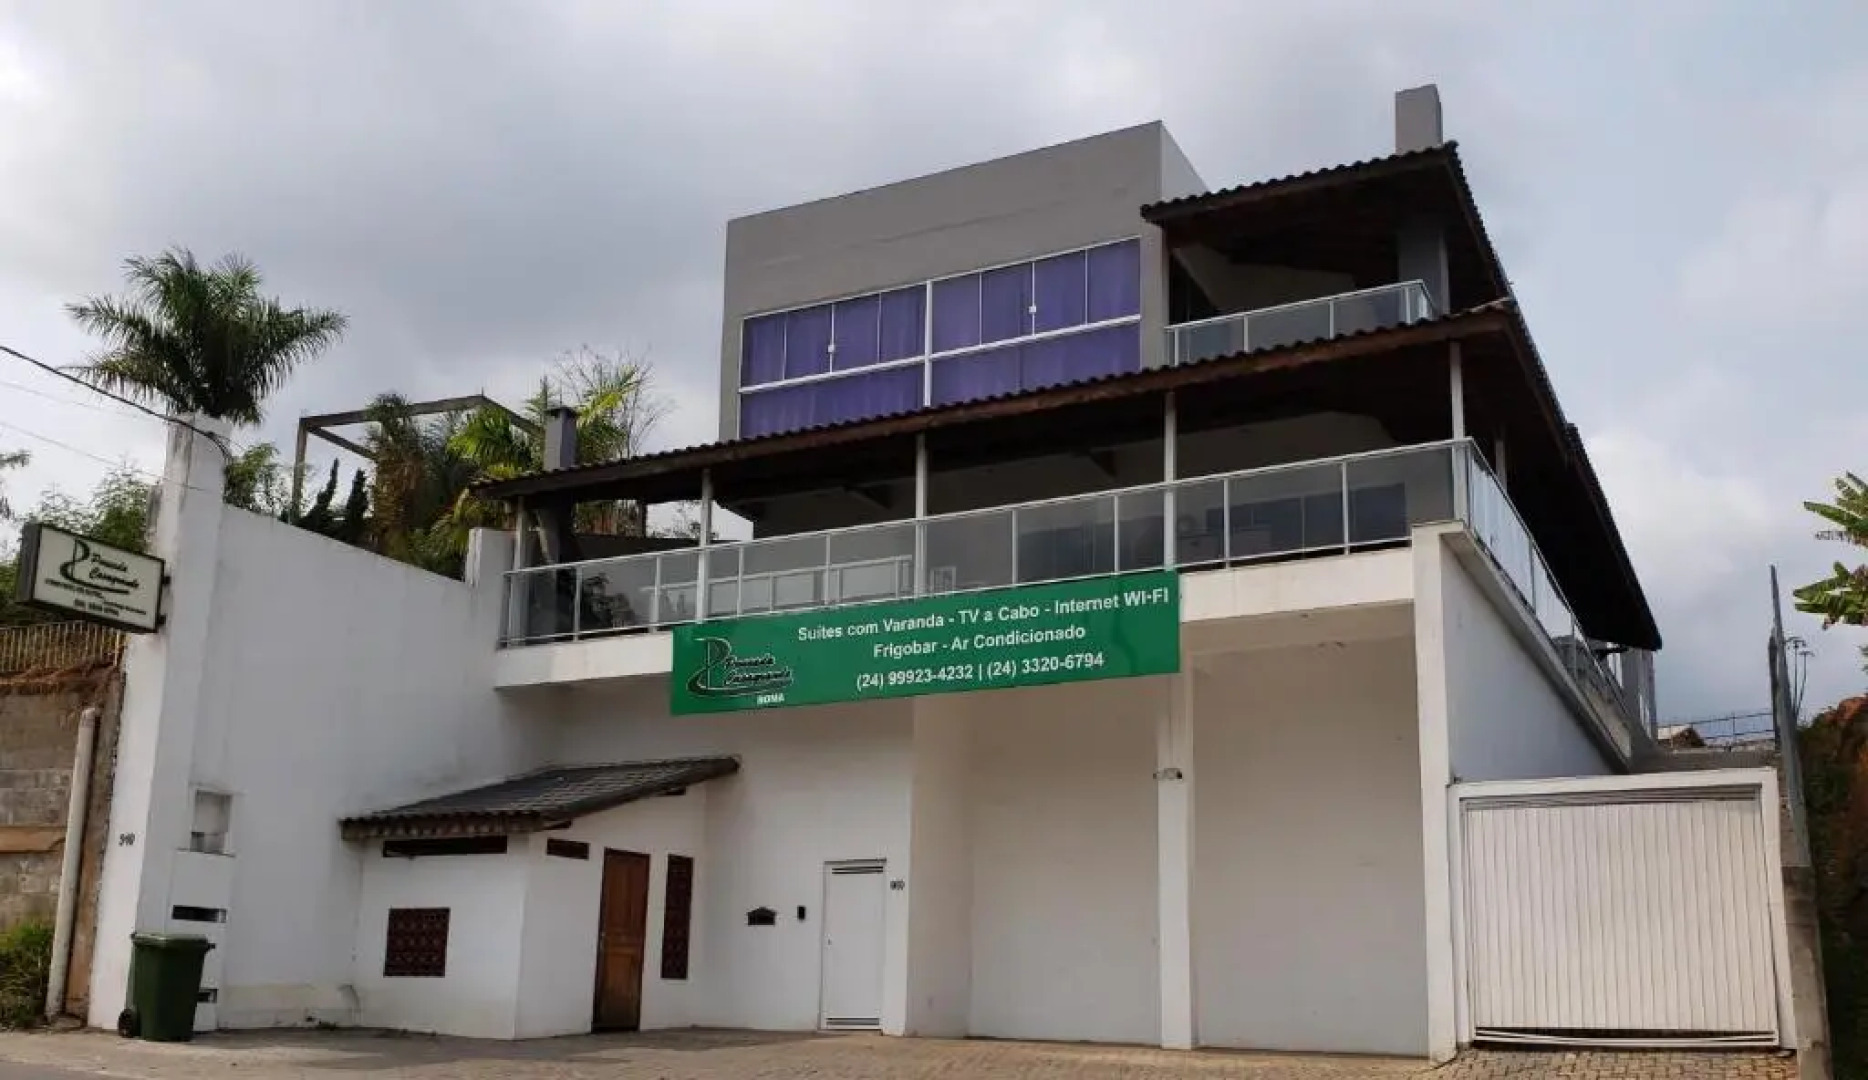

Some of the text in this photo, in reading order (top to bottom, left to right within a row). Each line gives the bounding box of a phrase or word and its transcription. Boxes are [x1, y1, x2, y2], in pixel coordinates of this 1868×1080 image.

[847, 623, 879, 637] com
[883, 613, 944, 632] Varanda
[958, 609, 980, 624] TV
[983, 610, 993, 622] a
[997, 605, 1039, 621] Cabo
[1055, 594, 1119, 614] Internet
[1124, 587, 1168, 607] WI-FI
[873, 641, 938, 659] Frigobar
[951, 636, 969, 650] Ar
[973, 624, 1086, 648] Condicionado
[856, 673, 884, 692] (24)
[888, 664, 973, 685] 99923-4232
[986, 659, 1017, 682] (24)
[1022, 652, 1104, 674] 3320-6794
